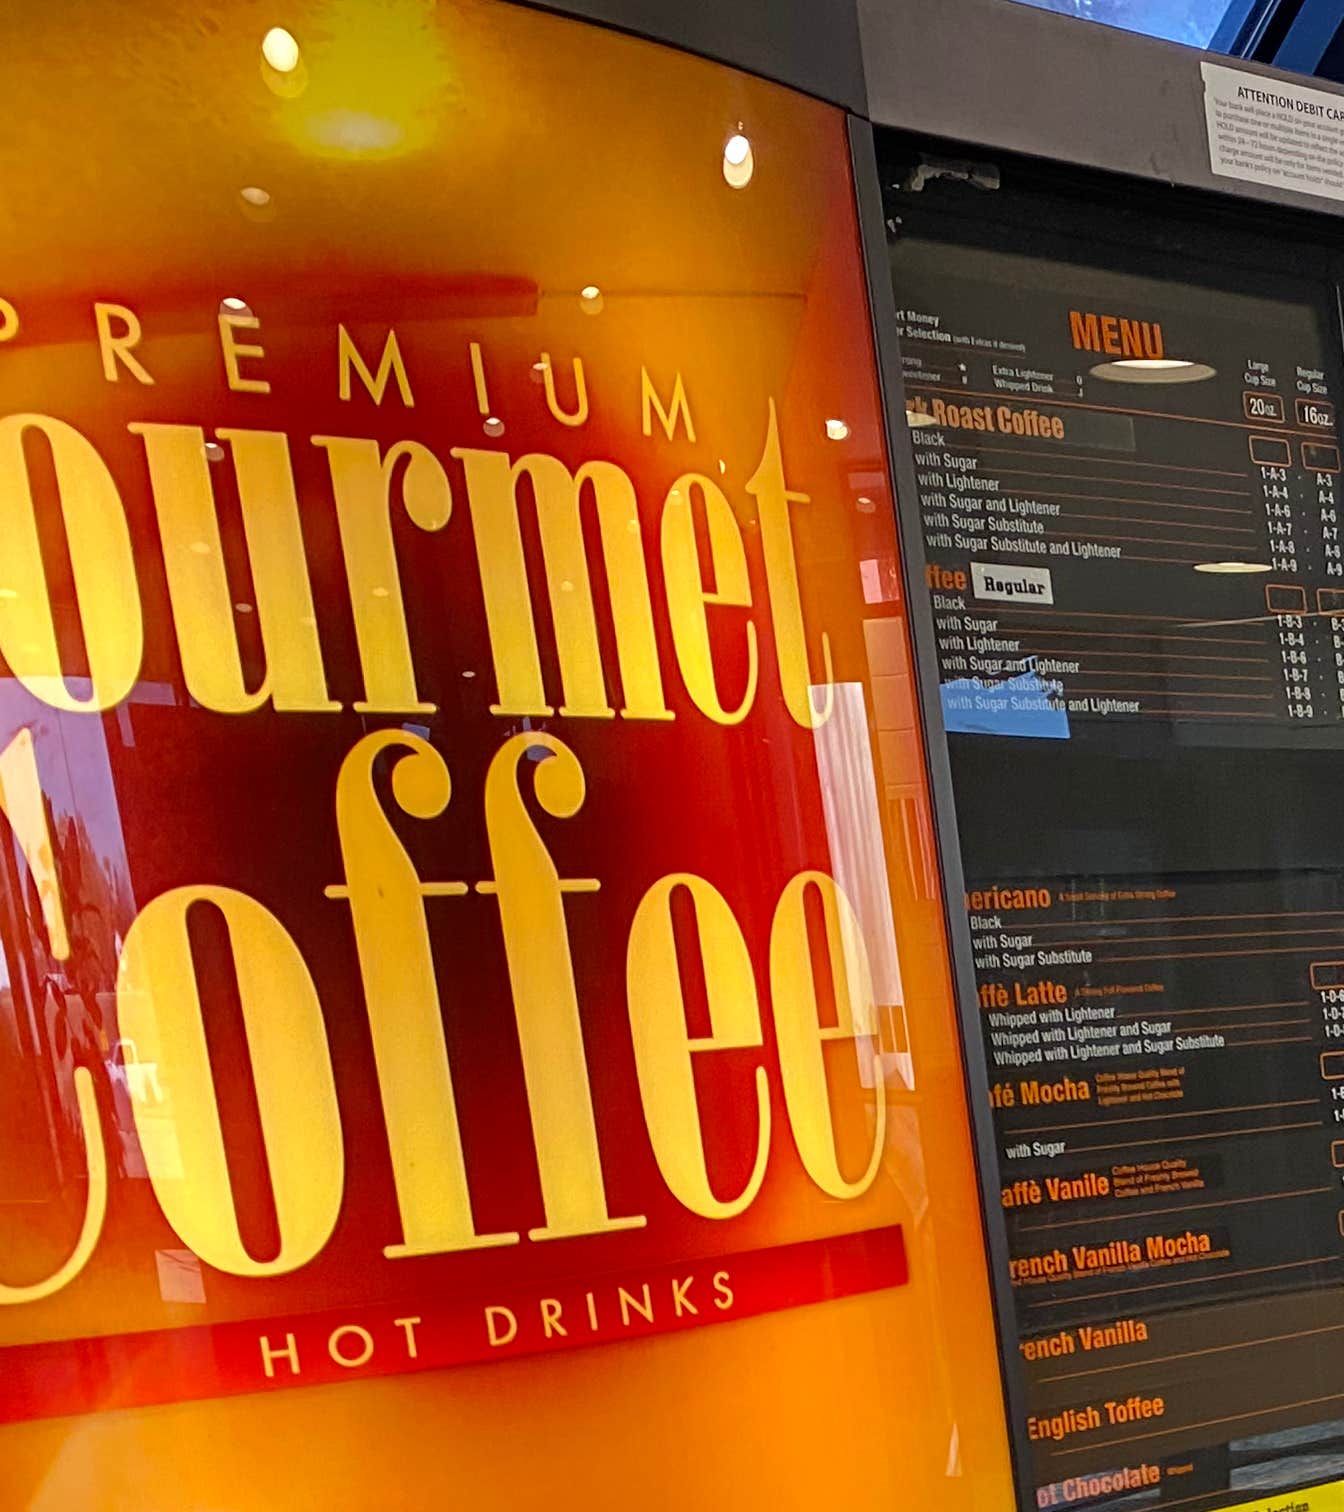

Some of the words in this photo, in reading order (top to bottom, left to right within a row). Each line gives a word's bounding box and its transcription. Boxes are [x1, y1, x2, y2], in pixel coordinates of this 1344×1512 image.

[1237, 86, 1294, 111] ATTENTION
[1296, 100, 1324, 117] DEBIT
[906, 310, 939, 327] Money
[906, 326, 951, 342] Selection
[1069, 311, 1164, 359] MENU
[931, 398, 995, 432] Roast
[996, 405, 1065, 440] Coffee
[912, 429, 945, 447] Black
[915, 452, 941, 467] with
[943, 453, 978, 471] Sugar
[918, 473, 944, 488] with
[946, 474, 1000, 492] Lightener
[921, 493, 947, 508] with
[949, 494, 983, 512] Sugar
[986, 497, 1007, 512] and
[1009, 499, 1061, 516] Lightener
[924, 513, 949, 528] with
[952, 514, 985, 532] Sugar
[988, 516, 1044, 534] Substitute
[926, 533, 951, 548] with
[954, 534, 988, 551] Sugar
[991, 535, 1047, 554] Substitute
[1050, 540, 1069, 555] and
[1071, 541, 1121, 559] Lightener
[983, 576, 1046, 596] Regular
[933, 595, 966, 611] Black
[936, 616, 962, 630] with
[964, 617, 998, 634] Sugar
[939, 637, 965, 650] with
[966, 638, 1020, 655] Lightener
[942, 656, 967, 670] with
[969, 657, 1001, 672] Sugar
[1007, 658, 1026, 672] and
[1028, 658, 1080, 675] Lightener
[947, 695, 973, 709] with
[976, 696, 1007, 713] Sugar
[1011, 697, 1066, 711] Substitute
[1069, 698, 1088, 711] and
[1090, 698, 1140, 716] Lightener
[970, 915, 1002, 930] Black
[972, 935, 998, 950] with
[1000, 934, 1033, 951] Sugar
[975, 954, 1001, 969] with
[1002, 953, 1035, 969] Sugar
[1037, 949, 1093, 966] Substitute
[1014, 980, 1067, 1007] Latte
[988, 1010, 1038, 1029] Whipped
[1039, 1009, 1064, 1022] with
[1065, 1006, 1116, 1024] Lightener
[991, 1030, 1040, 1048] Whipped
[1042, 1028, 1066, 1042] with
[1067, 1025, 1117, 1043] Lightener
[1120, 1023, 1139, 1037] and
[1141, 1020, 1172, 1038] Sugar
[993, 1049, 1042, 1067] Whipped
[1045, 1047, 1069, 1061] with
[1070, 1044, 1120, 1062] Lightener
[1122, 1041, 1142, 1055] and
[1144, 1039, 1174, 1056] Sugar
[1175, 1034, 1225, 1051] Substitute
[1020, 1076, 1091, 1106] Mocha
[1005, 1142, 1031, 1159] with
[1033, 1140, 1066, 1158] Sugar
[1072, 1240, 1141, 1270] Vanilla
[1145, 1231, 1211, 1261] Mocha
[258, 1315, 425, 1378] HOT
[486, 1268, 738, 1348] DRINKS
[1078, 1319, 1149, 1351] Vanilla
[1027, 1406, 1100, 1441] English
[1104, 1396, 1165, 1425] Toffee
[1062, 1463, 1161, 1502] Chocolate
